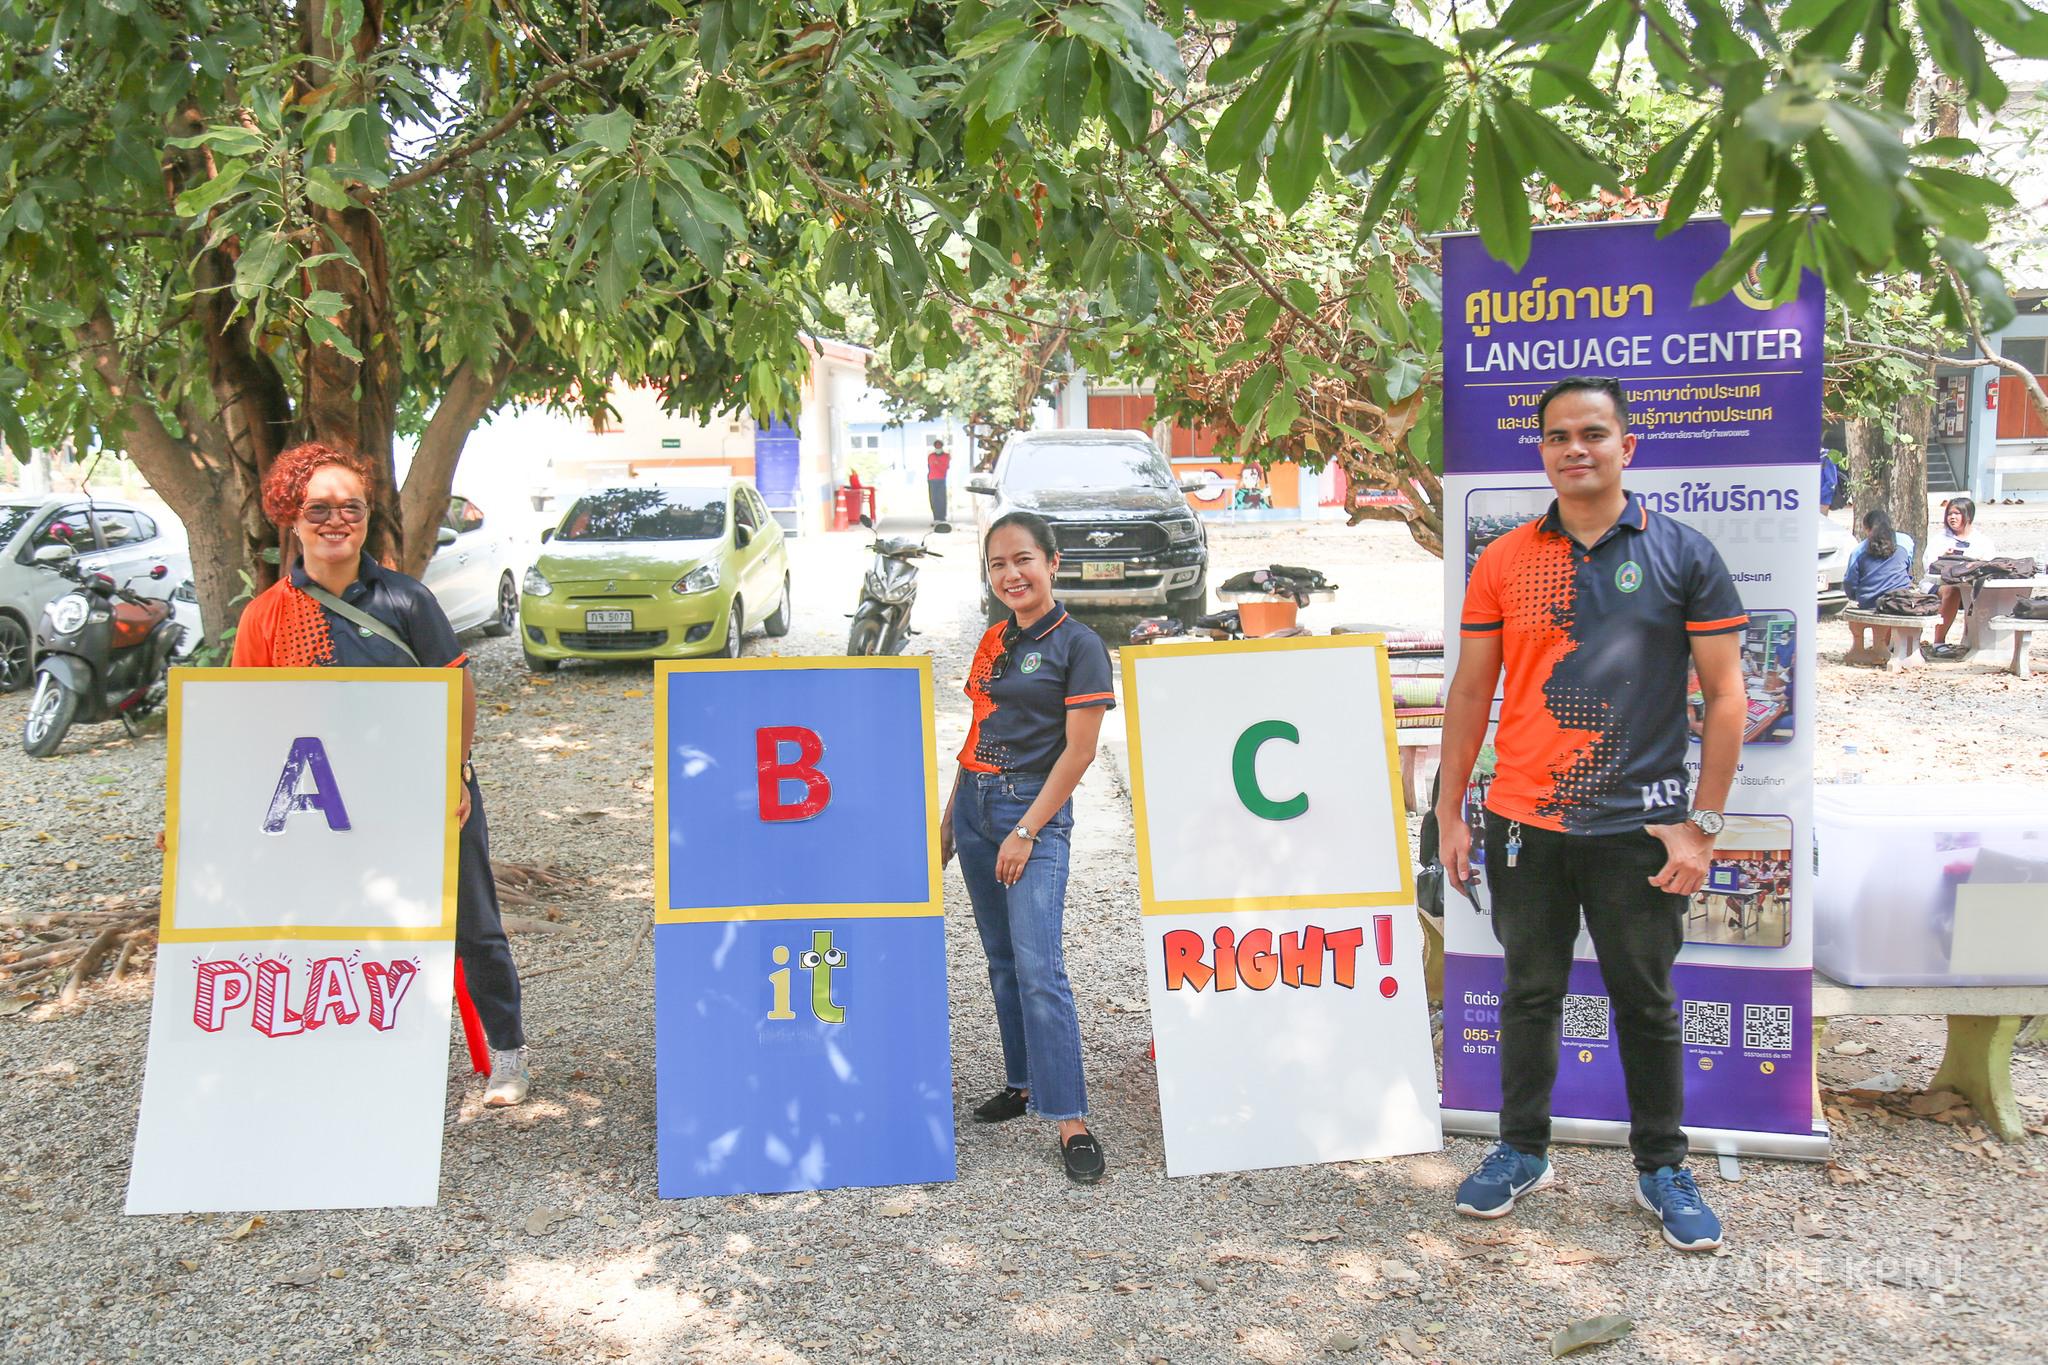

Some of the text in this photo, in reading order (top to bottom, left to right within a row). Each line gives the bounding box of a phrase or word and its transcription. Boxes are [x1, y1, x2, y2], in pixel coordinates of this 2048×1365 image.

[1464, 276, 1653, 337] ศูนย์ภาษา
[1464, 328, 1802, 373] LANGUAGE CENTER
[1497, 413, 1540, 430] และบริ
[260, 736, 352, 836] A
[755, 725, 832, 823] B
[1232, 720, 1310, 821] C
[1641, 778, 1683, 812] KP
[193, 954, 418, 1038] PLAY
[766, 929, 848, 1025] it
[1464, 990, 1499, 1006] ติดต่อ
[1463, 1008, 1499, 1023] CON
[1463, 1028, 1502, 1042] 055-7
[1477, 1045, 1496, 1054] 1571
